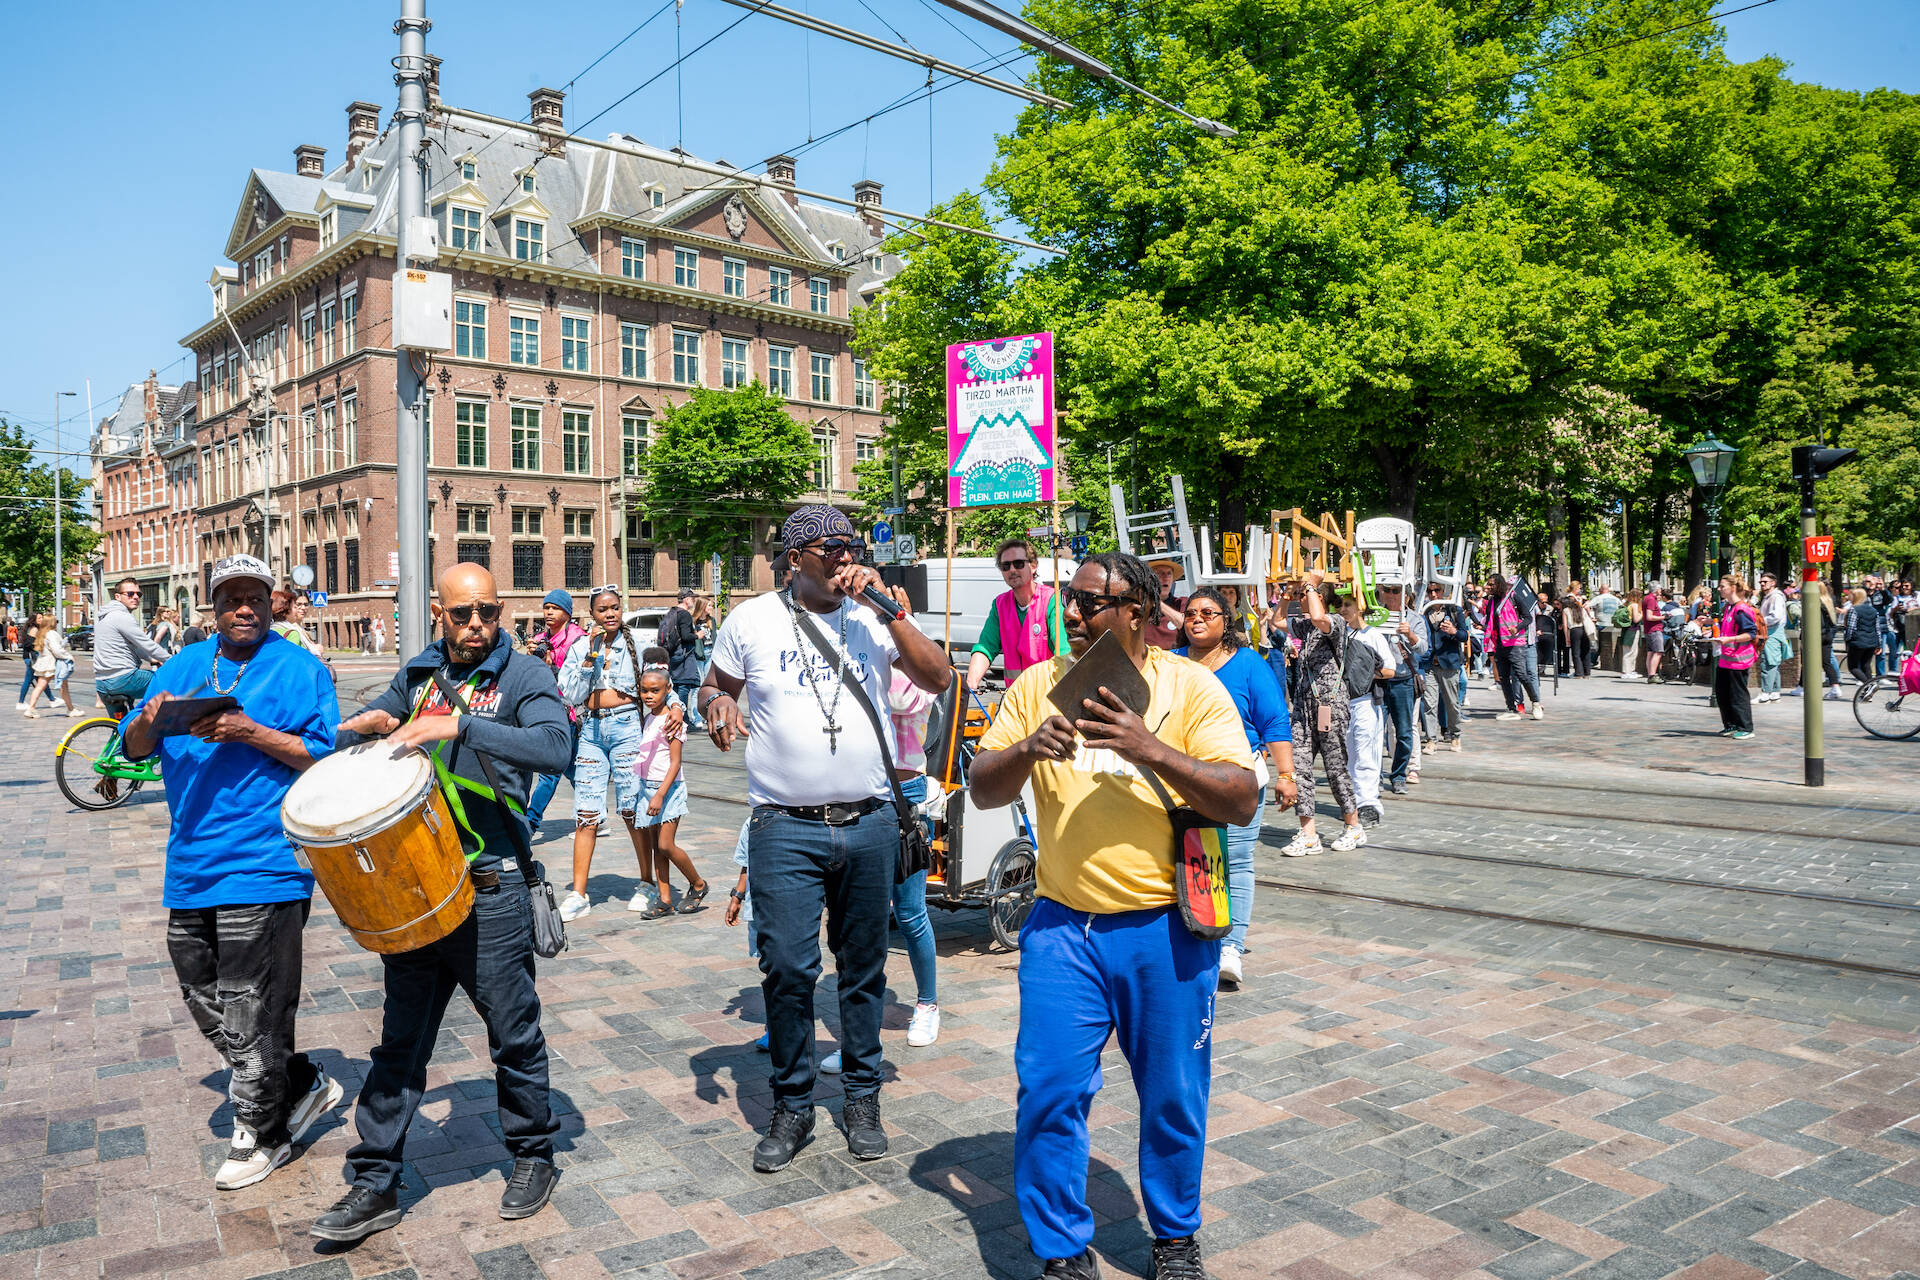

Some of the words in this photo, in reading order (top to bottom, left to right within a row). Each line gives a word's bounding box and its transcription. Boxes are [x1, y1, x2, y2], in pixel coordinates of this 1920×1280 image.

[966, 340, 1033, 380] KUNSTPARADE
[980, 343, 1017, 365] BINNENHOF
[965, 390, 990, 400] TIRZO
[996, 385, 1034, 397] MARTHA
[1008, 403, 1031, 412] KAMER
[968, 481, 974, 490] 27
[971, 468, 983, 481] MEI
[986, 467, 997, 478] T/M
[1000, 473, 1008, 483] 30
[1007, 464, 1020, 474] MEI
[1022, 467, 1034, 486] 2023
[969, 493, 991, 502] PLEIN,
[994, 491, 1009, 500] DEN
[1012, 489, 1033, 499] HAAG
[1811, 541, 1831, 557] 157
